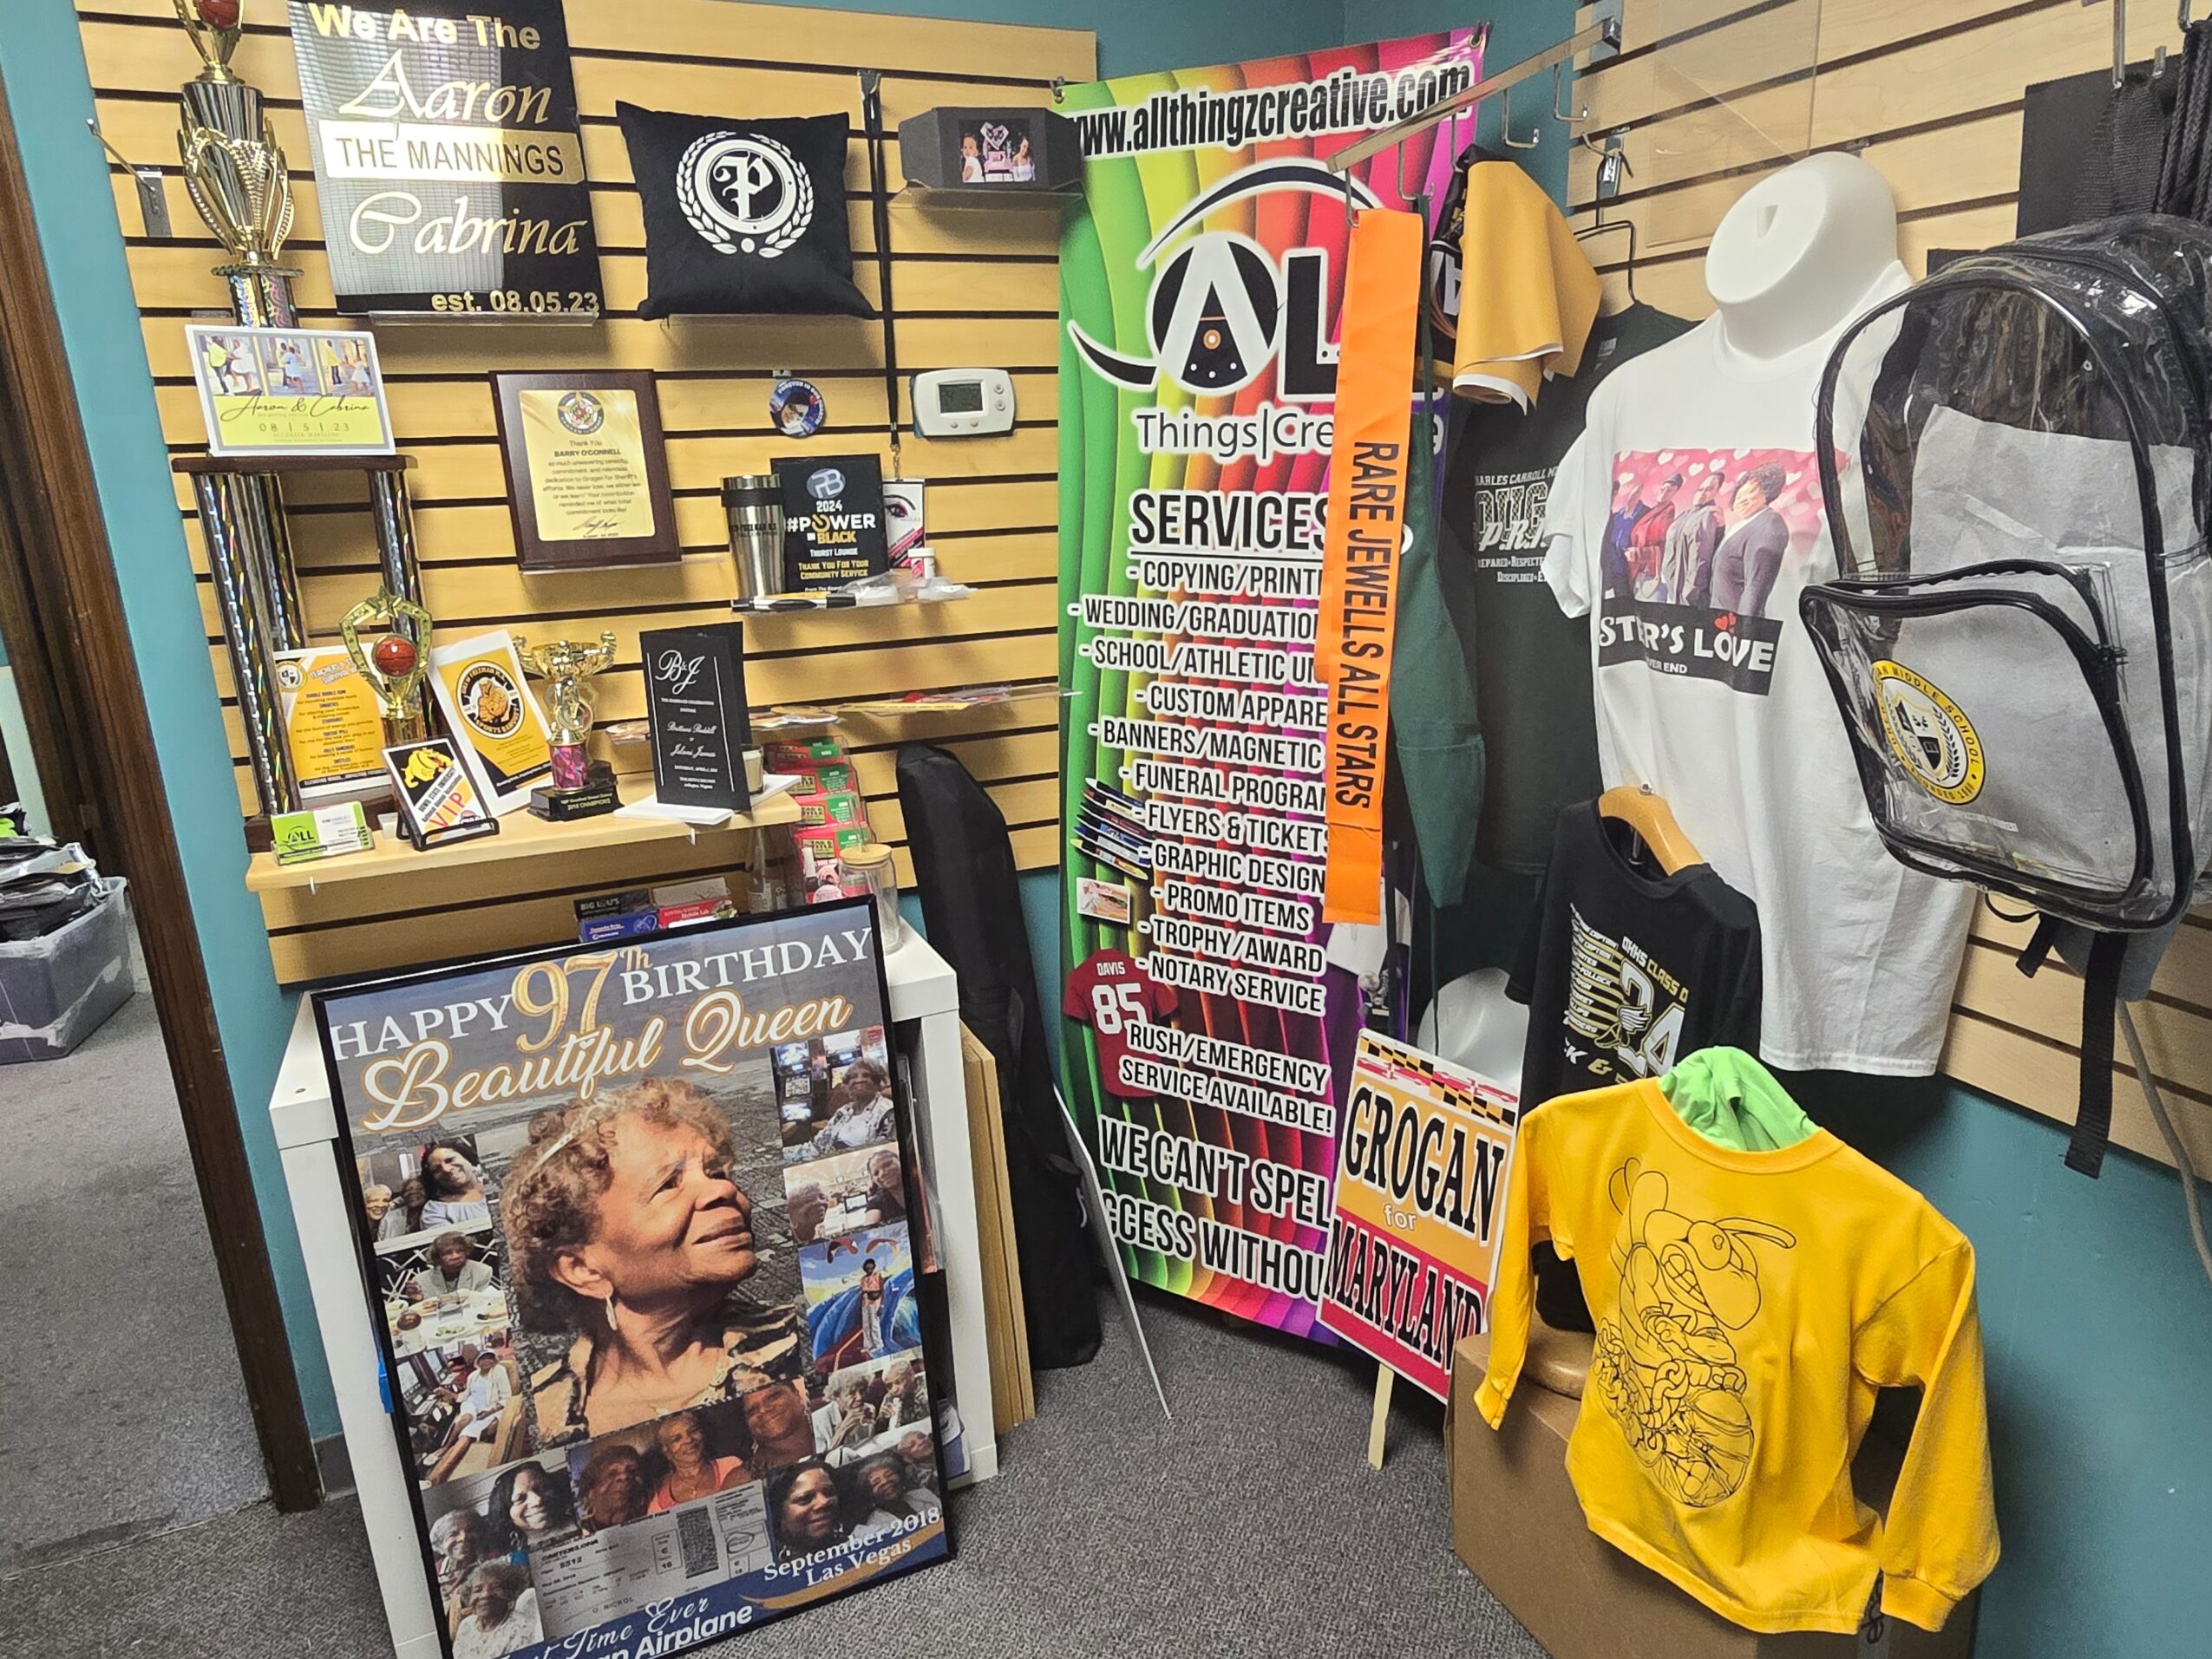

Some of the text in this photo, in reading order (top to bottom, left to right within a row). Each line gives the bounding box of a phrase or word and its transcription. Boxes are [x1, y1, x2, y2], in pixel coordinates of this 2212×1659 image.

[307, 3, 540, 49] We Are The
[338, 49, 552, 124] Aaron
[335, 137, 564, 176] THE MANNINGS
[350, 192, 587, 255] Cabrina
[431, 291, 599, 314] est. 08.05.23
[816, 500, 842, 513] 2024
[817, 531, 857, 545] BLACK
[1334, 441, 1400, 809] RARE JEWELLS ALL STARS
[1095, 640, 1285, 680] SCHOOL/ATHLETIC
[1664, 663, 1687, 674] END
[1693, 628, 1774, 672] LOVE
[1150, 686, 1328, 728] CUSTOM APPARE
[1894, 665, 1980, 765] MIDDLE SCHOOL
[1136, 763, 1226, 799] FUNERAL
[429, 792, 465, 827] VIP
[1149, 805, 1220, 837] FLYERS
[1227, 816, 1240, 838] &
[1155, 844, 1242, 880] GRAPHIC
[1168, 884, 1310, 931] PROMO ITEMS
[1096, 960, 1126, 976] DAVIS
[1154, 918, 1323, 973] TROPHY/AWARD
[330, 994, 514, 1061] HAPPY
[619, 927, 872, 1006] BIRTHDAY
[1152, 957, 1323, 1012] NOTARY SERVICE
[1646, 959, 1680, 996] CLASS
[1092, 983, 1148, 1035] 85
[363, 990, 853, 1131] Beautiful Queen
[1130, 1023, 1326, 1092] RUSH/EMERGENCY
[1122, 1059, 1332, 1133] SERVICE AVAILABLE!
[1102, 1119, 1145, 1174] WE
[1155, 1134, 1246, 1201] CAN'T
[1345, 1085, 1505, 1243] GROGAN
[1384, 1205, 1417, 1231] for
[1202, 1220, 1324, 1302] WITHOU
[763, 1506, 940, 1581] September 2018
[806, 1539, 911, 1586] Las Vegas
[564, 1623, 632, 1659] Time
[645, 1596, 709, 1633] Ever
[634, 1605, 752, 1659] Airplane
